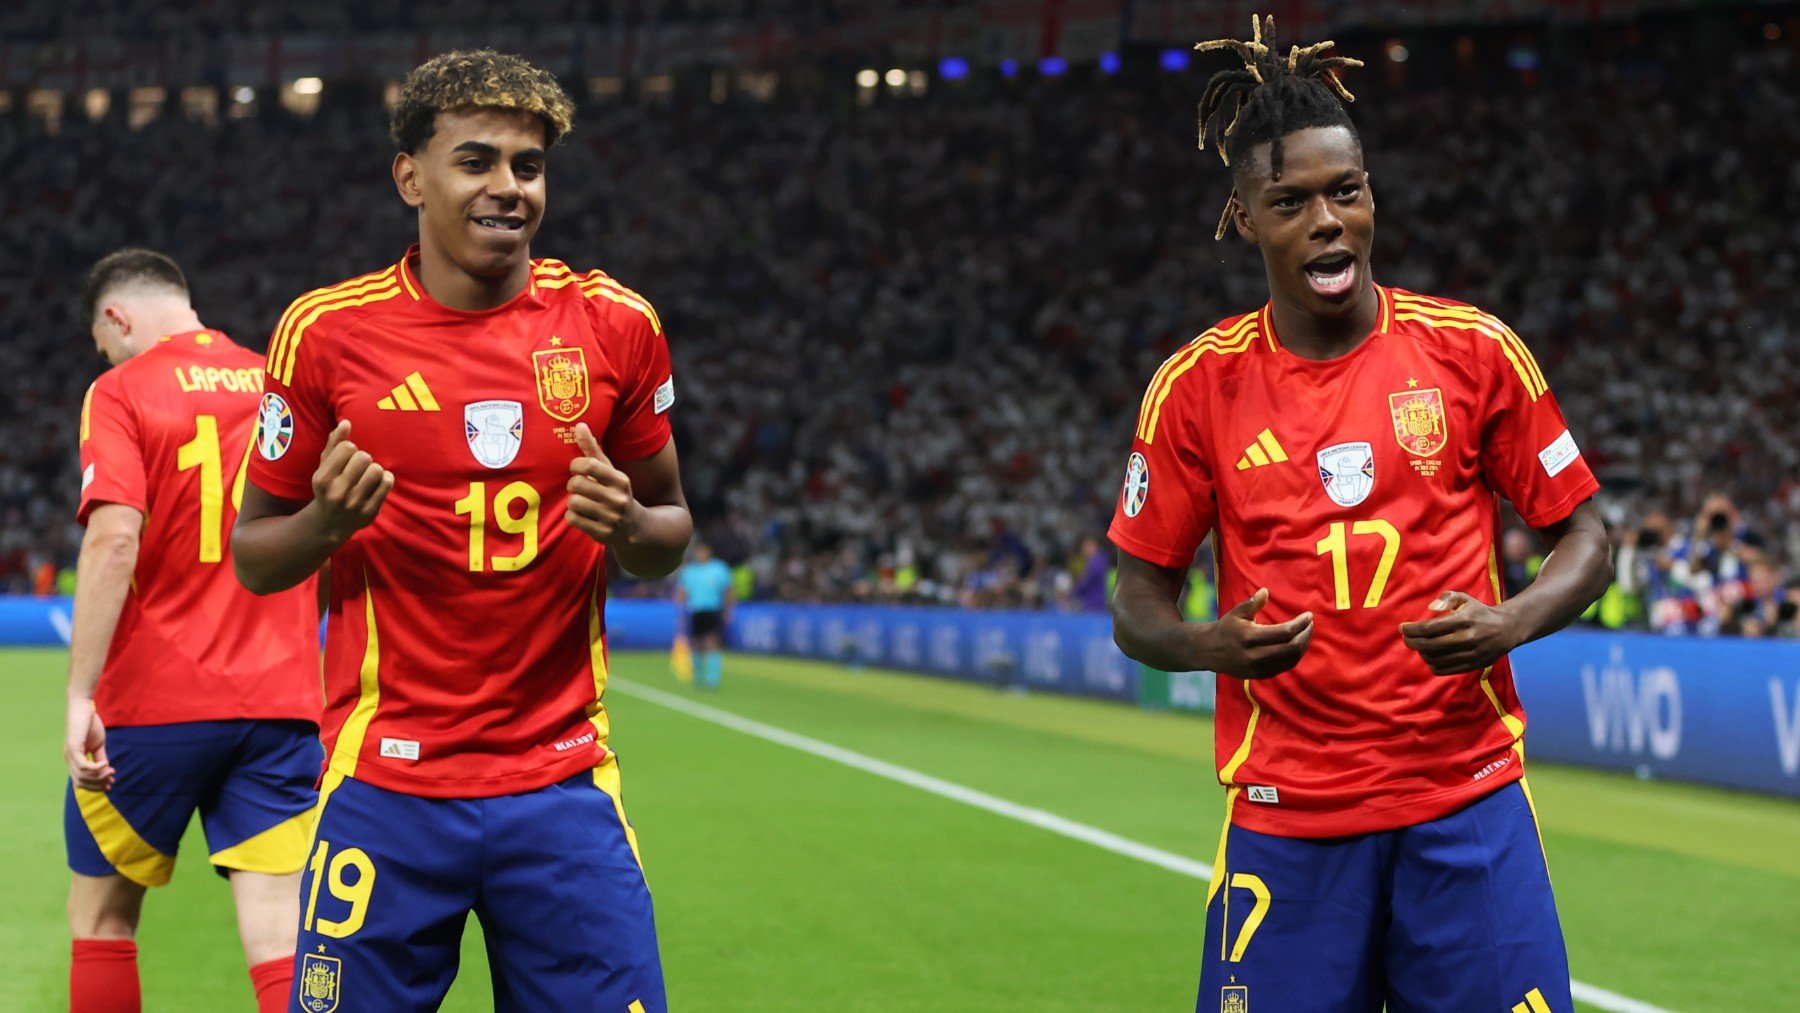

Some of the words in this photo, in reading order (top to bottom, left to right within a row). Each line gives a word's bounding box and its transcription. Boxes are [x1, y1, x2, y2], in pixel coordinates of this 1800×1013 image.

[174, 365, 265, 393] LAPORT
[455, 481, 541, 572] 19
[1316, 519, 1401, 610] 17
[304, 840, 377, 939] 19
[1221, 872, 1272, 963] 17
